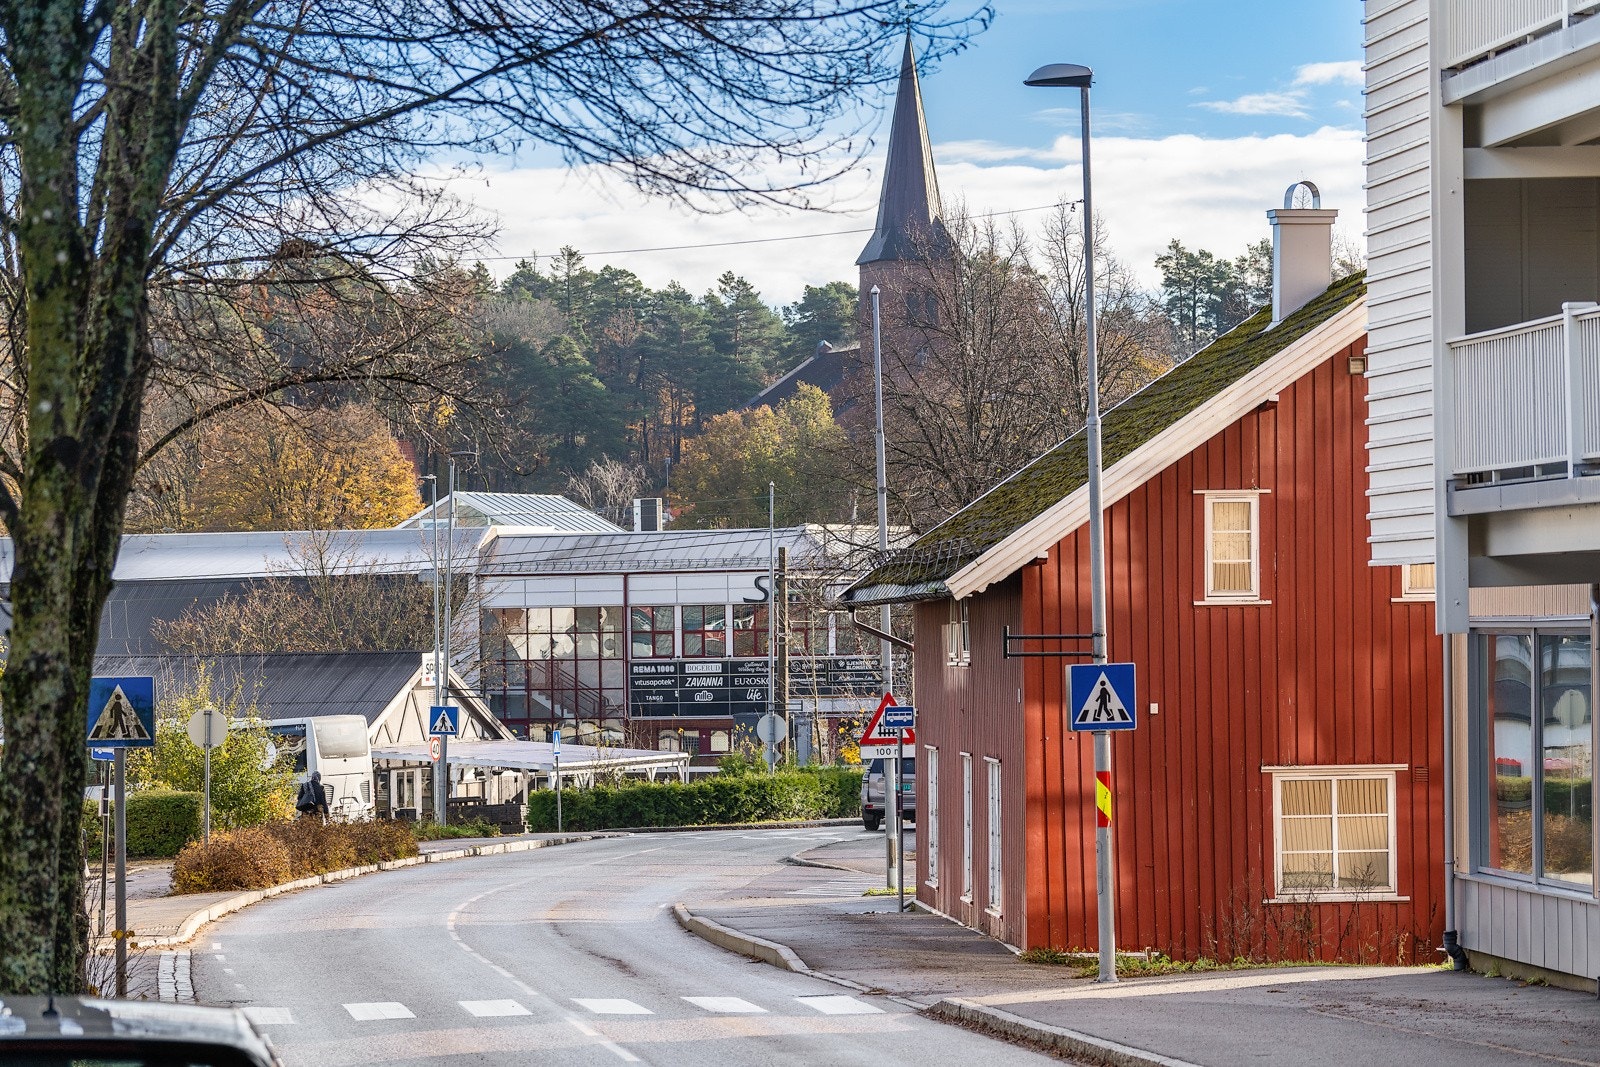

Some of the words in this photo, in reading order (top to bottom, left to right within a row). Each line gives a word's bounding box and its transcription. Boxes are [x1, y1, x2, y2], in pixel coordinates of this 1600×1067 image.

[633, 665, 656, 674] REMA
[657, 665, 675, 673] 1000
[687, 664, 721, 672] BOGERUD
[685, 676, 723, 687] ZAVANNA
[432, 743, 440, 755] 40
[876, 748, 892, 756] 100
